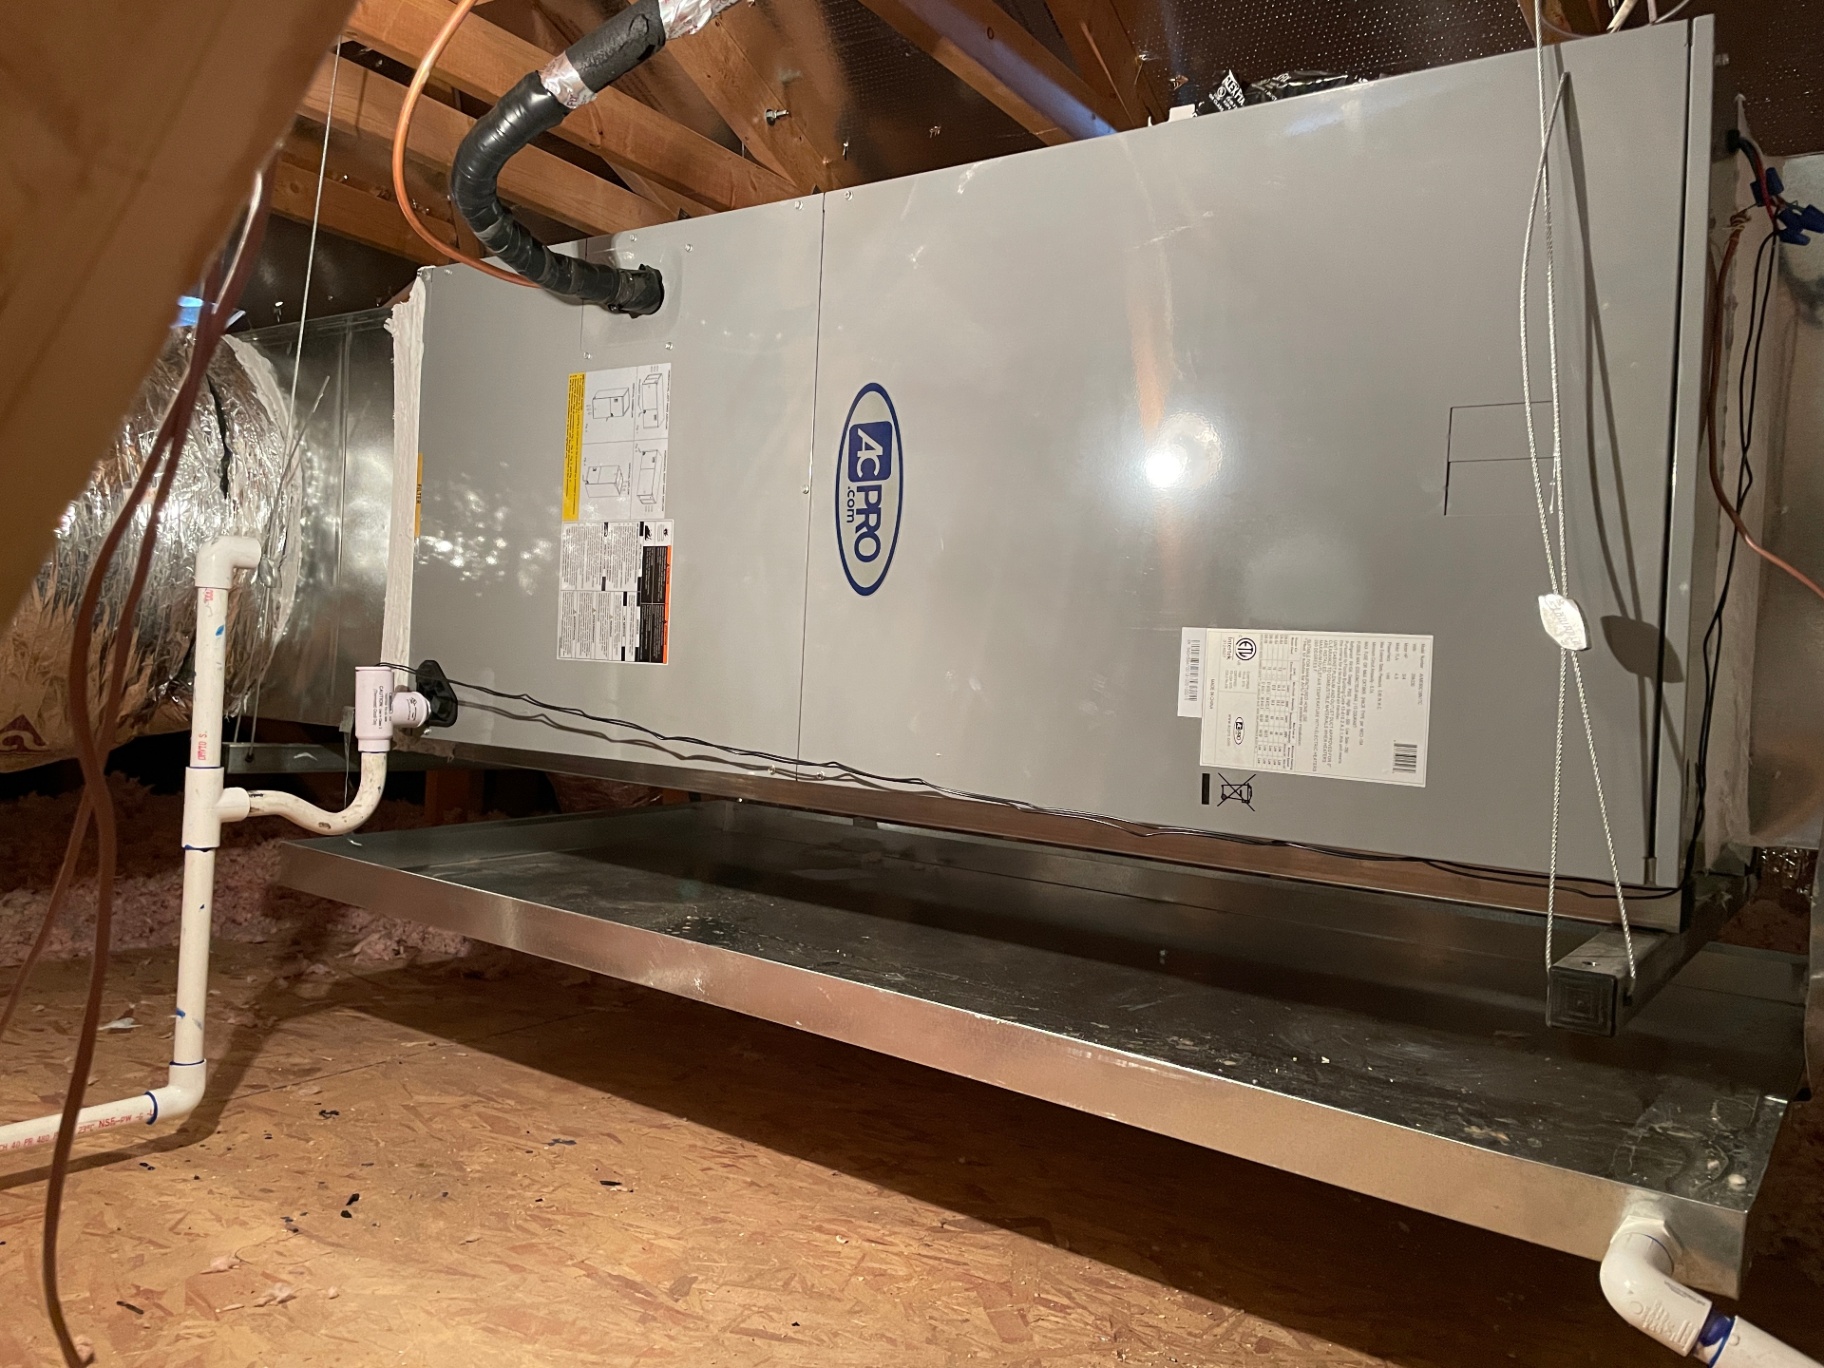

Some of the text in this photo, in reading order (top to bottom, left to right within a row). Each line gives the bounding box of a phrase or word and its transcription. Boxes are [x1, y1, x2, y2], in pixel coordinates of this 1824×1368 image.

[846, 486, 856, 523] .com
[854, 427, 883, 563] AC PRO
